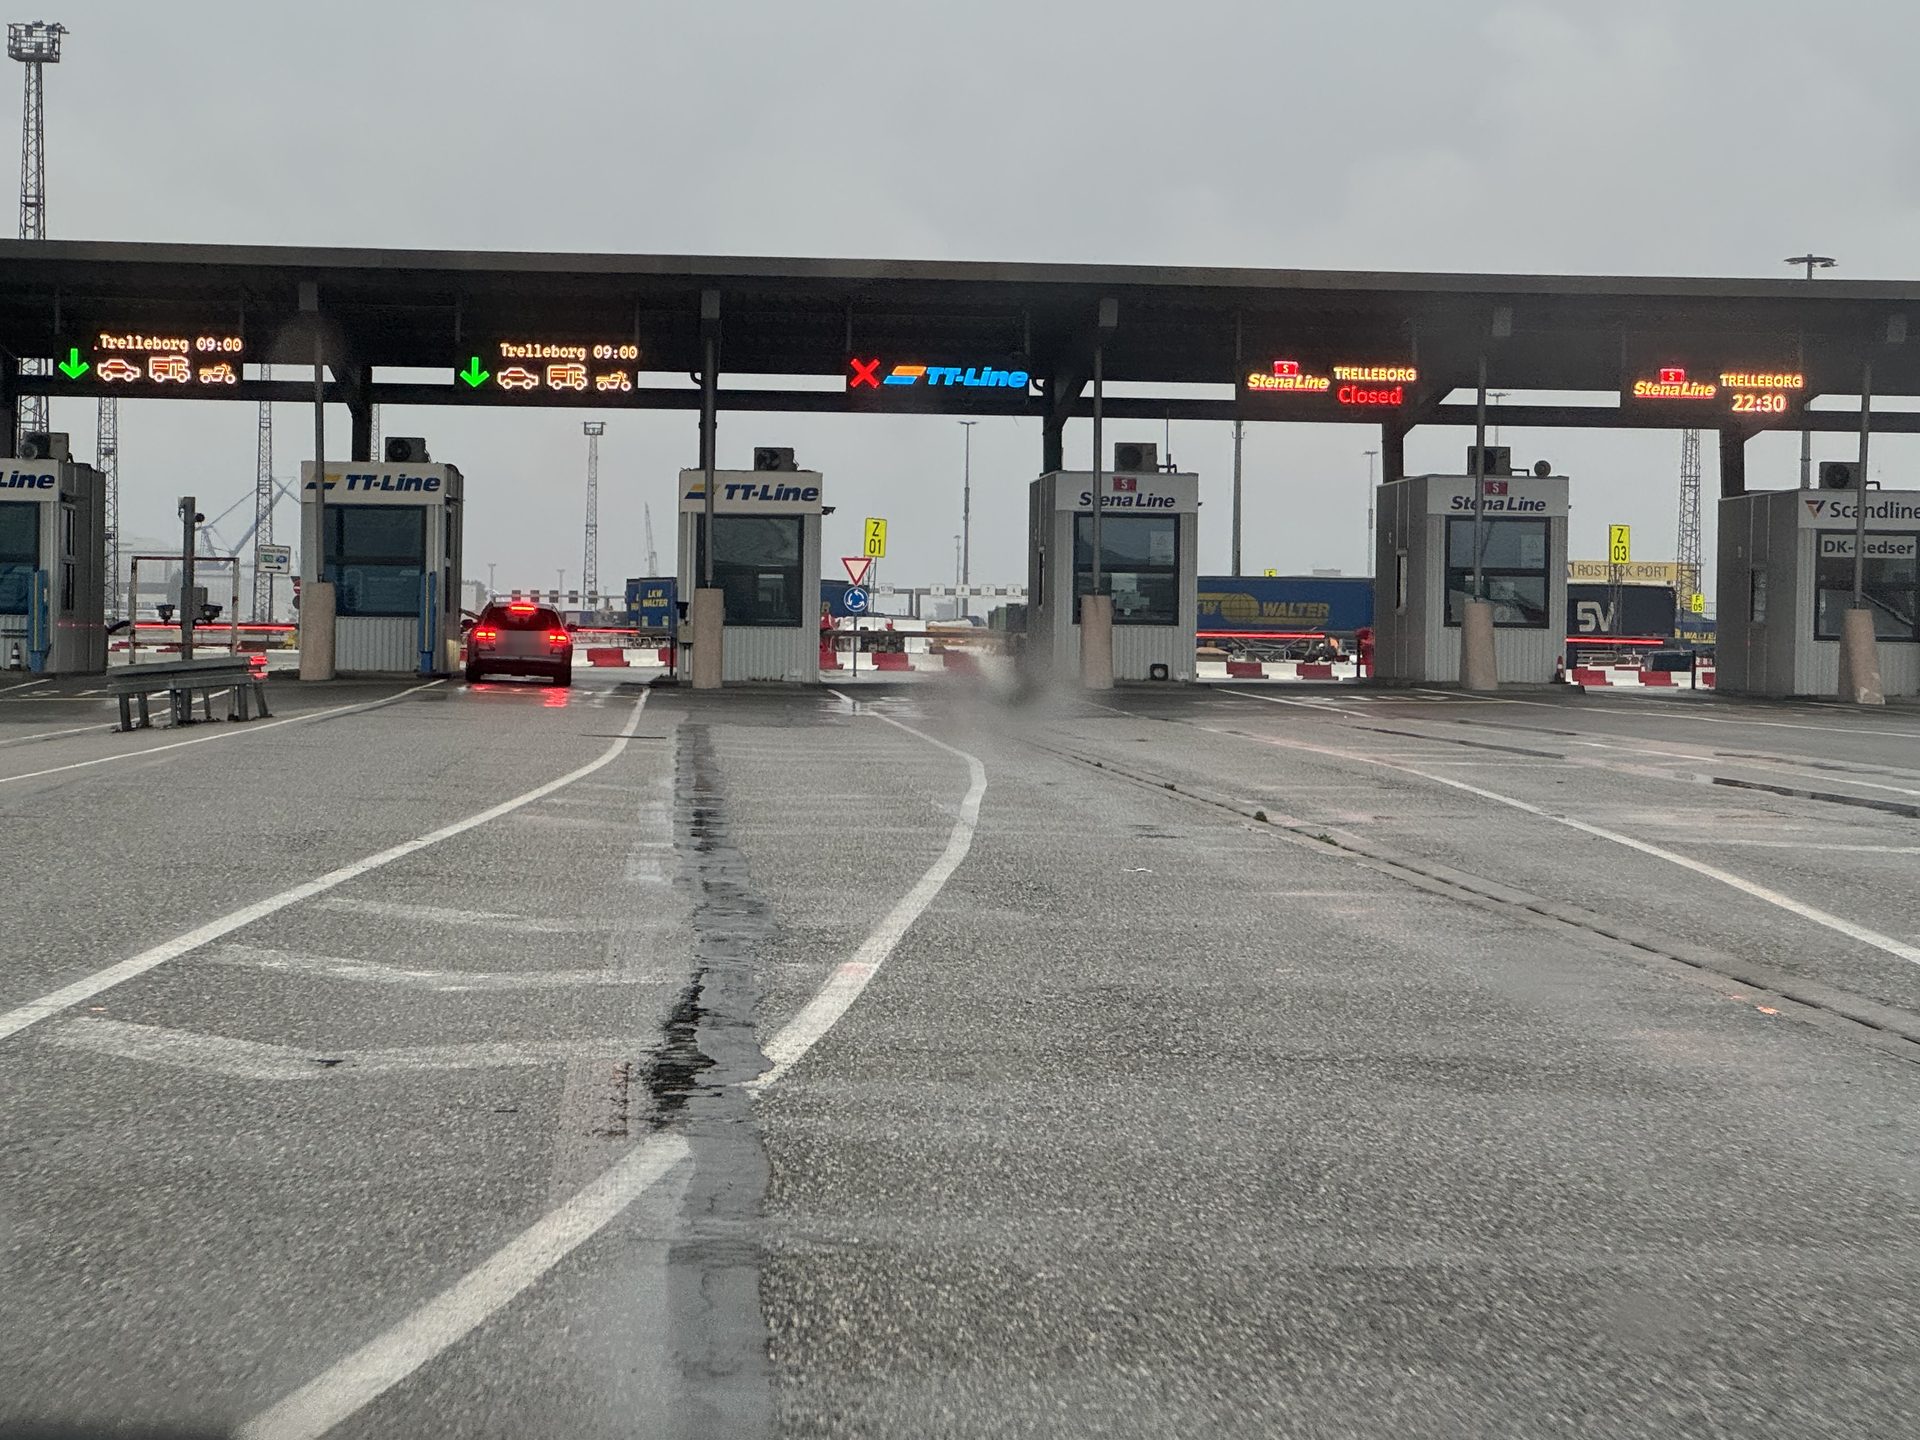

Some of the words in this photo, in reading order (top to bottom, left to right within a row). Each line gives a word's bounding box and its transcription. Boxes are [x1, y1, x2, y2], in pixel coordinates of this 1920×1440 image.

[100, 334, 189, 353] Trelleborg
[196, 337, 242, 352] 09:00
[500, 343, 587, 361] Trelleborg
[593, 345, 638, 359] 09:00
[926, 366, 1028, 388] TT-Line
[1334, 366, 1417, 381] TRELLEBORG
[1720, 374, 1803, 389] TRELLEBORG
[1338, 385, 1403, 405] Closed
[1731, 394, 1787, 413] 22:30
[345, 474, 441, 492] TT-Line
[725, 484, 819, 502] TT-Line
[1078, 492, 1133, 507] Sena
[1135, 493, 1176, 508] Line
[1506, 496, 1546, 511] Line
[872, 521, 881, 537] Z
[1616, 528, 1624, 543] Z
[869, 538, 882, 554] 01
[1613, 545, 1627, 561] 03
[1637, 565, 1669, 578] PORT
[1262, 602, 1329, 617] WALTER
